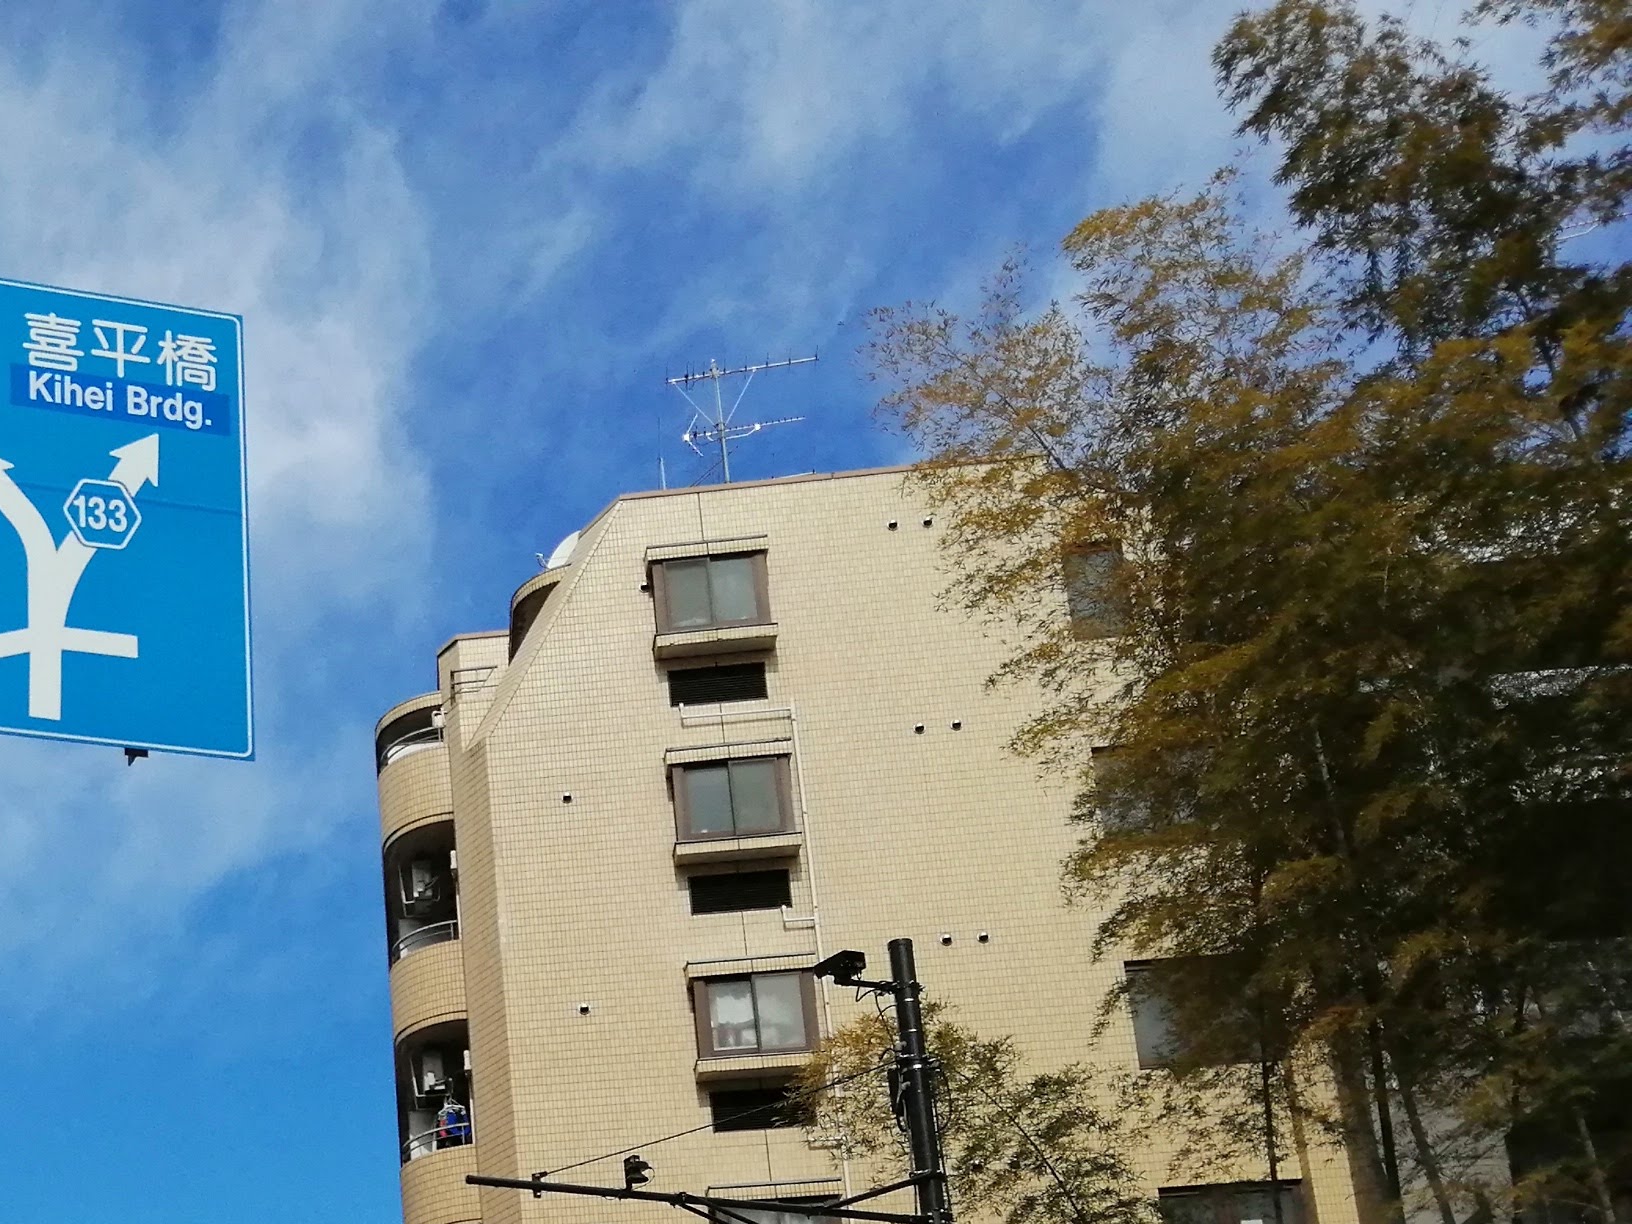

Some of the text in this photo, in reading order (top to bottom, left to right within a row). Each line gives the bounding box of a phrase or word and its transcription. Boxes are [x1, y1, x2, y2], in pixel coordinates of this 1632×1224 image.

[23, 313, 218, 391] 喜平橋
[29, 369, 213, 429] Kihei Brdg.
[72, 494, 129, 533] 133
